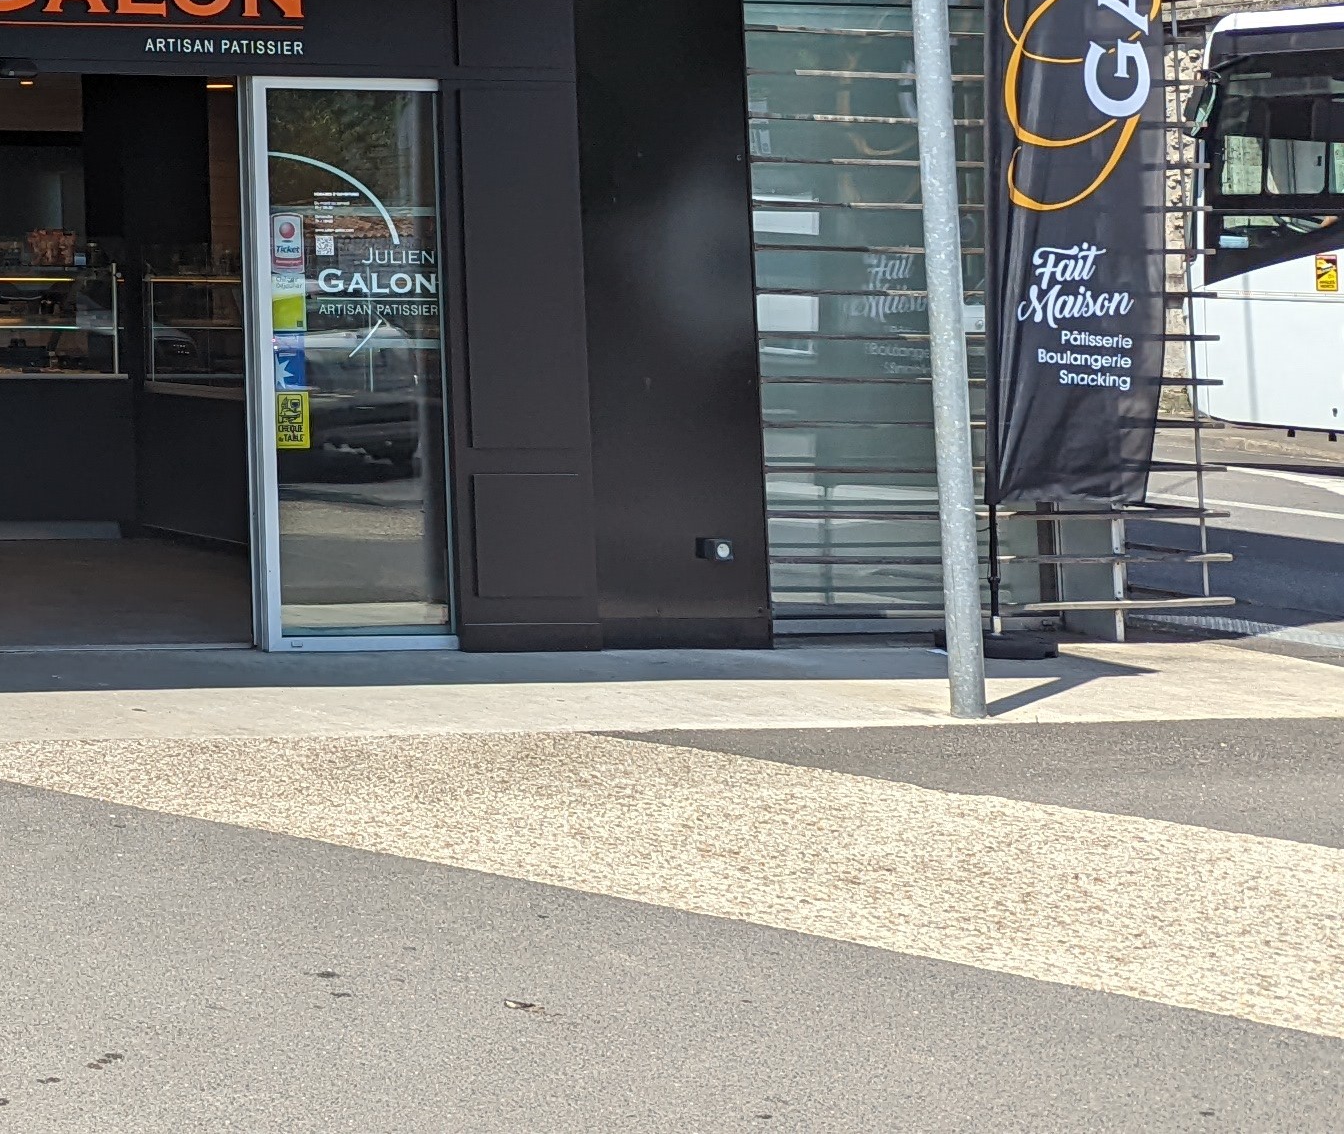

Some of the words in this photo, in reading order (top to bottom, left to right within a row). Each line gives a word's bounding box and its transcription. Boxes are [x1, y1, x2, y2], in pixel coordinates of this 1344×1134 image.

[145, 38, 214, 54] ARTISAN
[221, 39, 304, 55] PATISSIER
[276, 245, 300, 254] Ticket
[361, 247, 435, 265] JULIEN
[1033, 242, 1107, 290] Fait
[318, 268, 437, 294] GALON
[319, 304, 371, 315] ARTISAN
[377, 304, 439, 316] PATISSIER
[1017, 284, 1135, 329] Maison
[1061, 330, 1133, 349] Pâtisserie
[1037, 349, 1132, 369] Boulangerie
[1059, 370, 1131, 391] Snacking
